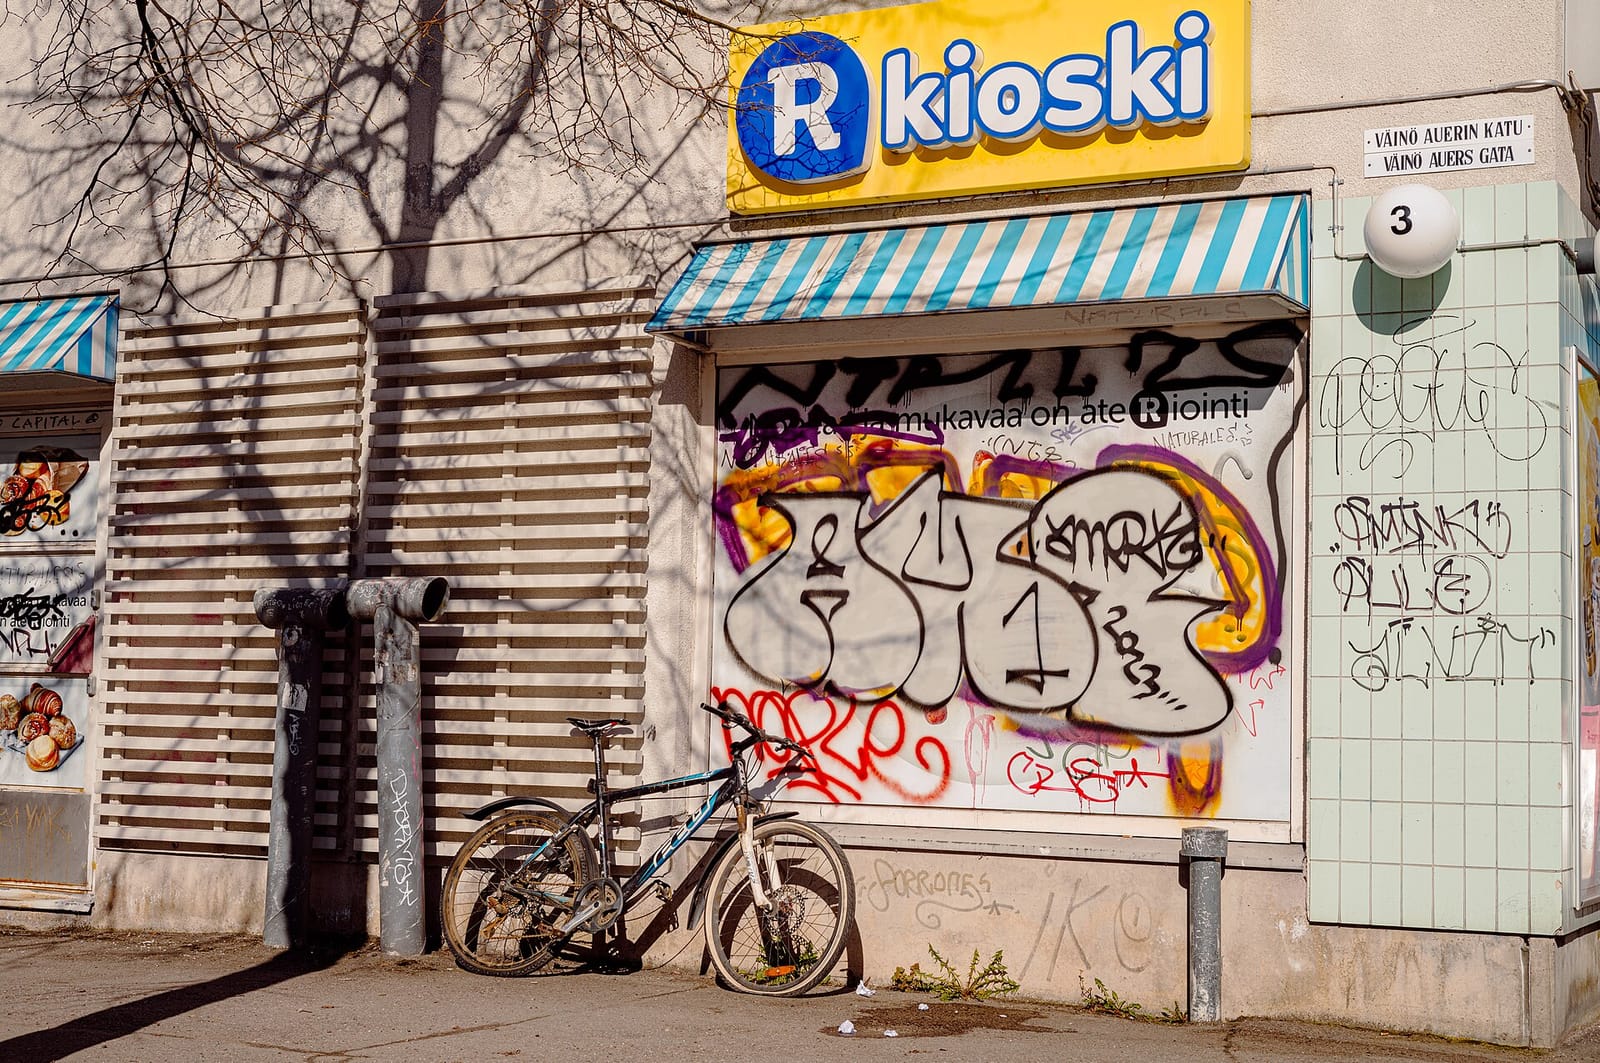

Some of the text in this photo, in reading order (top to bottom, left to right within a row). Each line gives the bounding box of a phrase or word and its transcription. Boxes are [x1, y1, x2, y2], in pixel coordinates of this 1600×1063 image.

[767, 9, 1212, 156] R kioski
[1375, 118, 1524, 149] VÄINÖ AUERIN KATU
[1384, 145, 1515, 172] VÄINÖ AUERS GATA
[1390, 205, 1413, 236] 3
[12, 413, 81, 429] CAPITAL
[895, 404, 1022, 432] mukavaa
[1030, 405, 1070, 427] on
